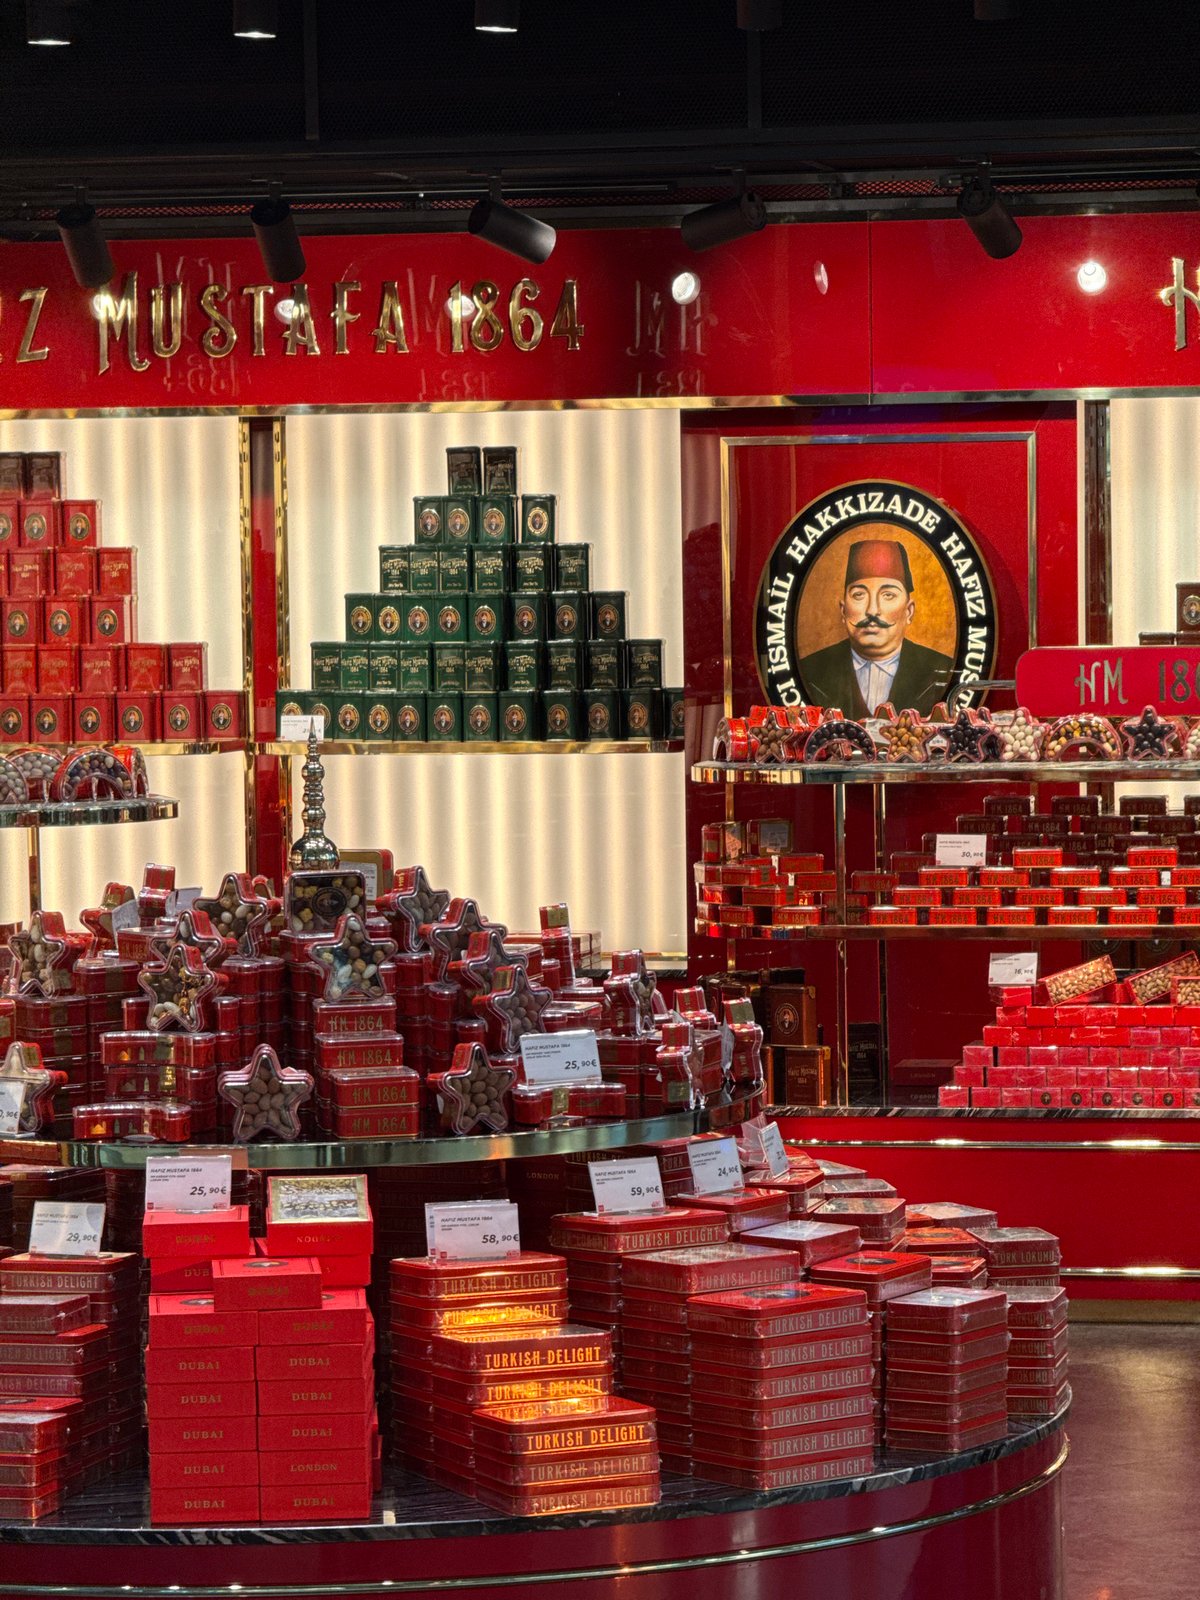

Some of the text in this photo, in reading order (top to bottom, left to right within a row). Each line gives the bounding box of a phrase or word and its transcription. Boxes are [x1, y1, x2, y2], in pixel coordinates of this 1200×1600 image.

[97, 271, 410, 376] MUSTAFA
[450, 278, 584, 351] 1864
[767, 572, 795, 675] İSMAİL
[786, 491, 942, 564] HAKKIZADE
[940, 532, 987, 618] HAFIZ
[1074, 657, 1200, 706] HM 18
[354, 1015, 384, 1031] 1864
[362, 1048, 392, 1065] 1864
[377, 1086, 408, 1102] 1864
[377, 1116, 407, 1132] 1864
[624, 1226, 720, 1249] TURKISH DELIGHT
[11, 1275, 98, 1289] TURKISH DELIGHT
[443, 1272, 556, 1295] TURKISH DELIGHT
[699, 1266, 795, 1289] TURKISH DELIGHT
[505, 1303, 557, 1321] DELIGHT
[768, 1306, 861, 1330] TURKISH DELIGHT
[485, 1346, 601, 1369] TURKISH DELIGHT
[771, 1339, 864, 1363] TURKISH DELIGHT
[179, 1361, 219, 1371] DUBAI
[289, 1358, 330, 1367] DUBAI
[549, 1378, 602, 1397] DELIGHT
[771, 1369, 865, 1395] TURKISH DELIGHT
[181, 1395, 222, 1404] DUBAI
[291, 1392, 333, 1401] DUBAI
[772, 1399, 866, 1426] TURKISH DELIGHT
[183, 1430, 224, 1440] DUBAI
[291, 1428, 333, 1437] DUBAI
[527, 1425, 645, 1451] TURKISH DELIGHT
[772, 1429, 866, 1456] TURKISH DELIGHT
[184, 1465, 225, 1475] DUBAI
[291, 1463, 337, 1472] LONDON
[529, 1456, 647, 1482] TURKISH DELIGHT
[772, 1459, 866, 1486] TURKISH DELIGHT
[184, 1500, 225, 1509] DUBAI
[531, 1488, 649, 1513] TURKISH DELIGHT
